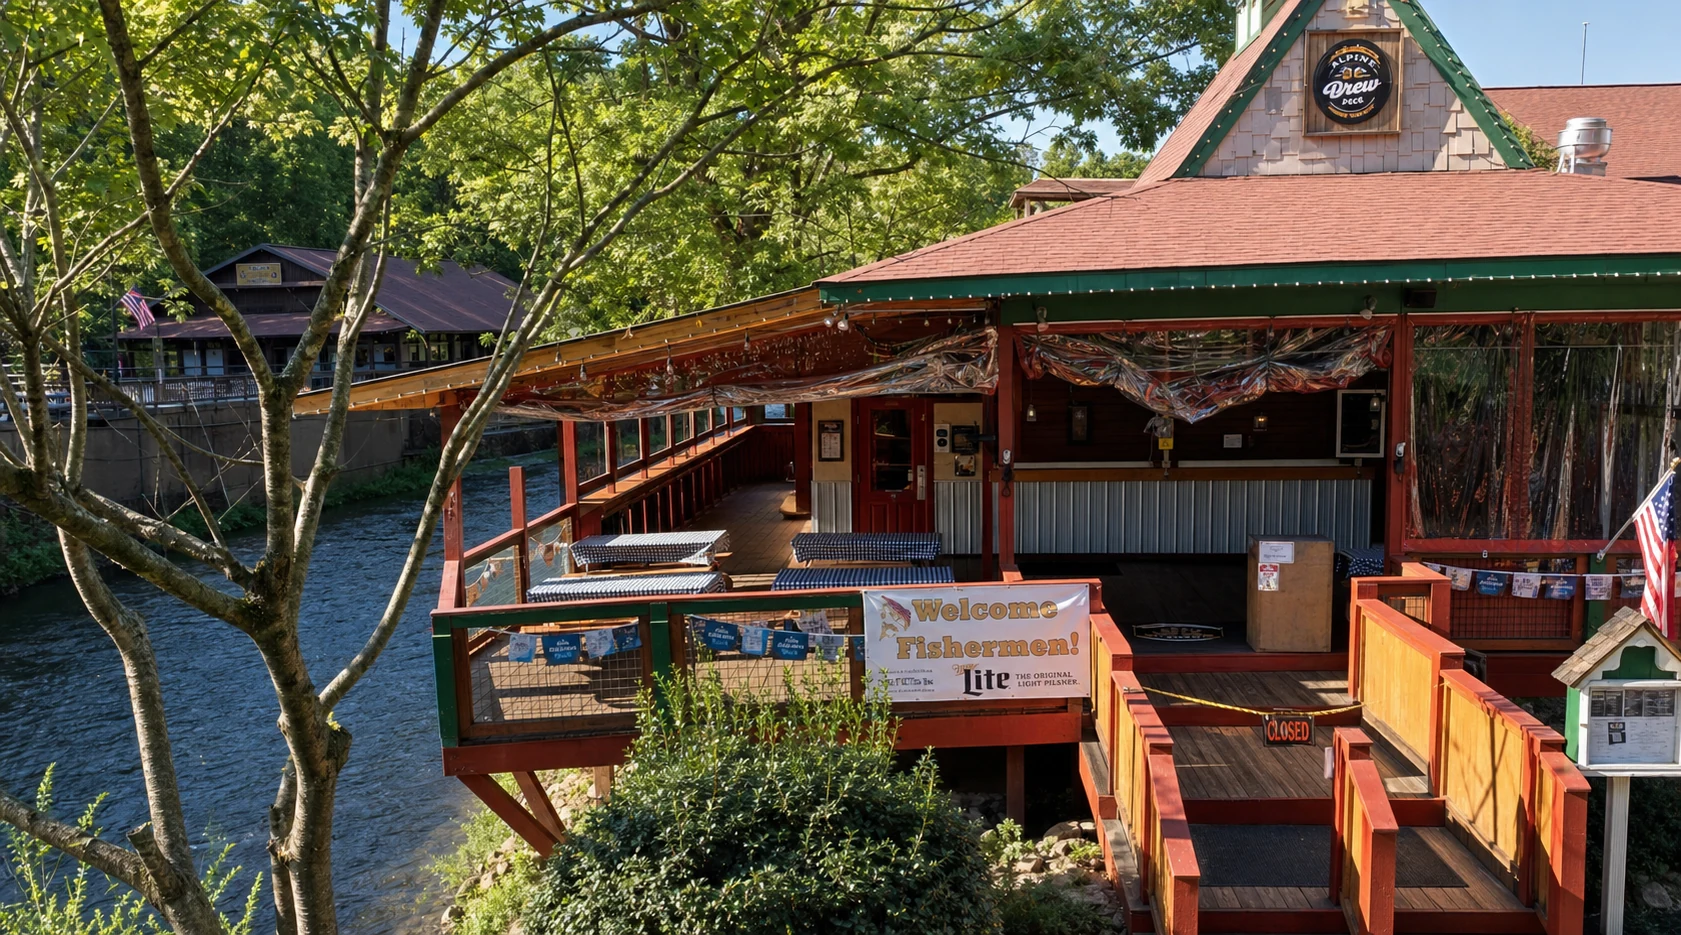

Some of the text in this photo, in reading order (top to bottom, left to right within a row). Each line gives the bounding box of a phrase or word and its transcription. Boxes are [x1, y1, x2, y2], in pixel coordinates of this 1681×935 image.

[1331, 54, 1377, 68] ALPINE
[911, 598, 1059, 622] Welcome
[896, 632, 1080, 660] Fishermen!
[963, 669, 1010, 697] Lite
[1033, 671, 1073, 679] ORIGINAL
[1267, 719, 1310, 741] CLOSED
